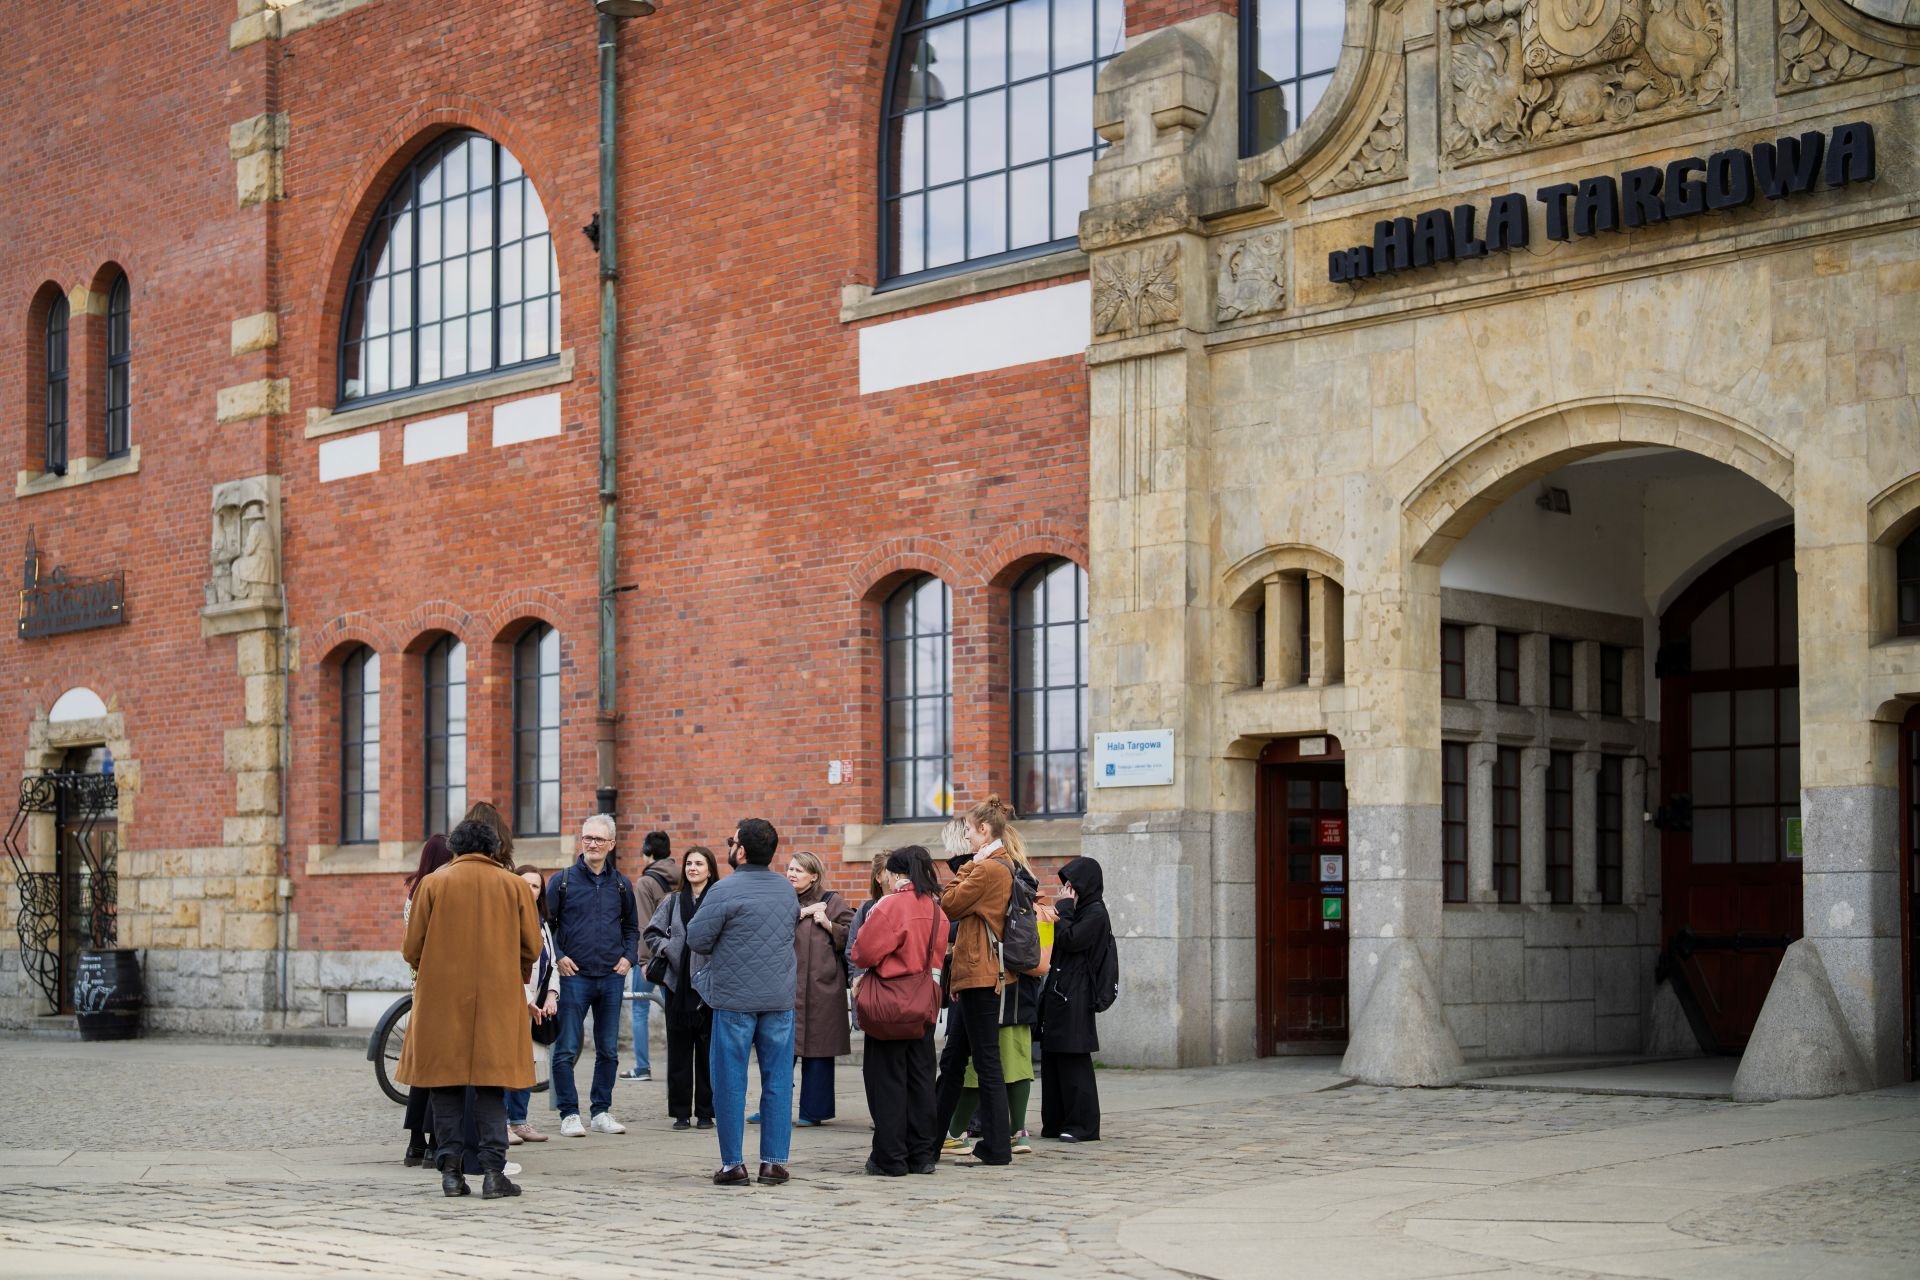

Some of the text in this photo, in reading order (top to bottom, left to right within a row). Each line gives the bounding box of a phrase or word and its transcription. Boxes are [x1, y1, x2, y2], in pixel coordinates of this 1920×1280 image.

[1329, 121, 1876, 283] DH HALA TARGOWA
[23, 578, 120, 619] TARGOWA
[1107, 741, 1161, 751] Hala Targowa
